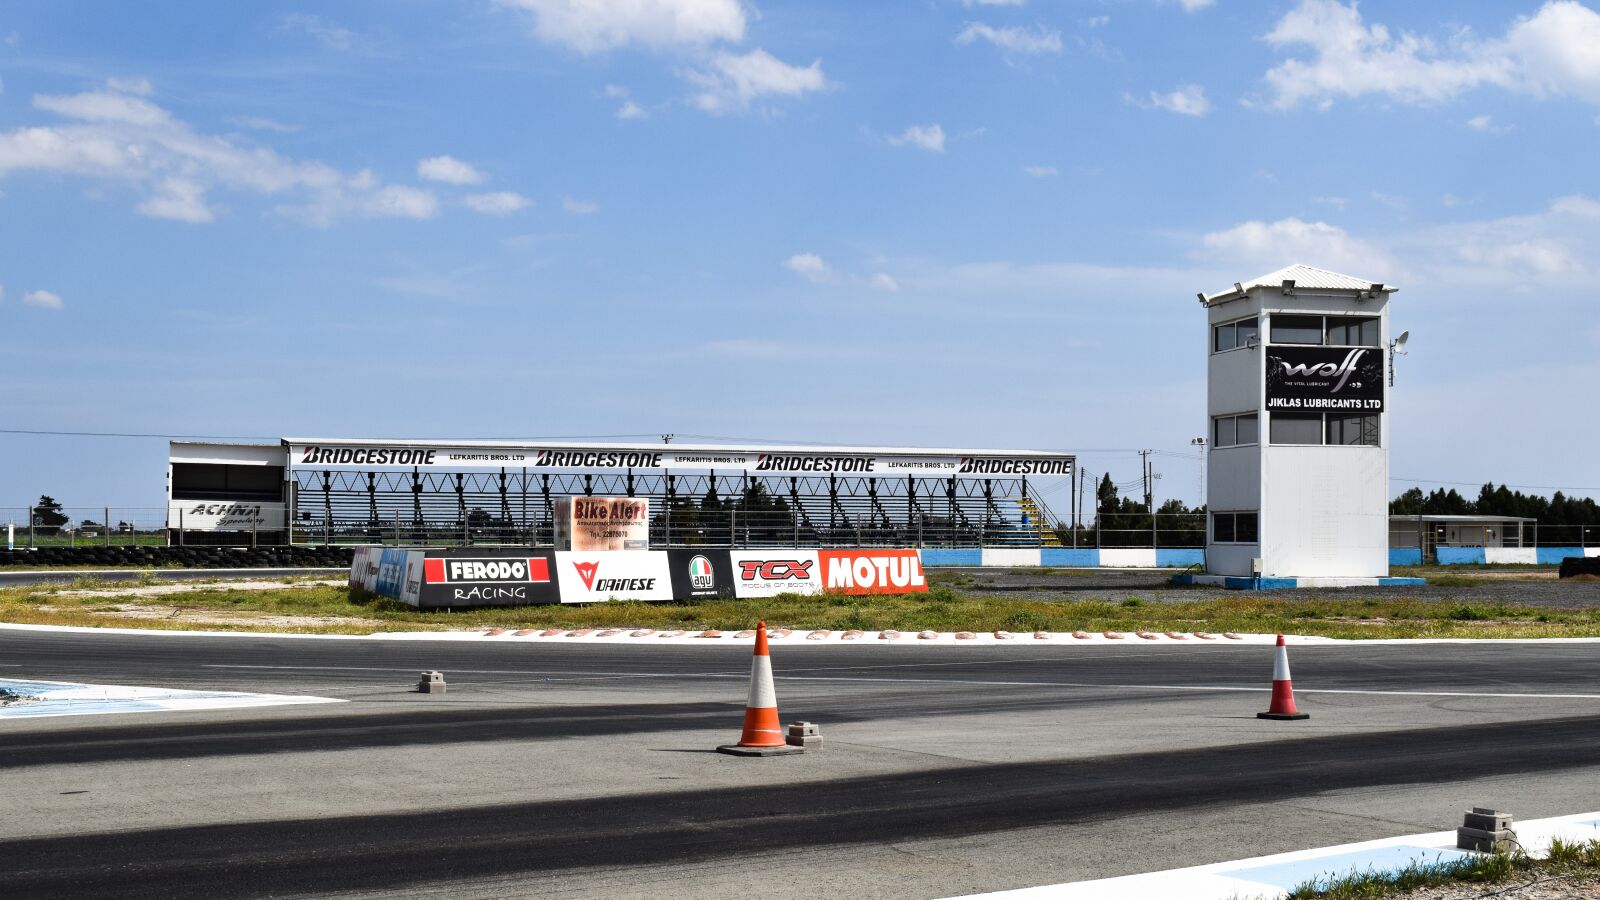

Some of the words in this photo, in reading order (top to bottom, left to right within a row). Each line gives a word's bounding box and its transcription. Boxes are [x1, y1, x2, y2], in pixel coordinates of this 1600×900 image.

[1268, 398, 1301, 408] JIKLAS
[1303, 398, 1362, 409] LUBRICANTS
[1364, 399, 1381, 409] LTD
[301, 445, 436, 465] BRIDGESTONE
[535, 450, 663, 468] BRIDGESTONE
[755, 453, 876, 472] BRIDGESTONE
[958, 457, 1072, 475] BRIDGESTONE
[188, 503, 261, 516] ACHNA
[574, 500, 608, 519] Bike
[609, 501, 646, 519] Alert
[450, 561, 525, 580] FERODO
[738, 559, 813, 580] TCX
[828, 556, 925, 589] MOTUL
[454, 586, 526, 599] RACING
[595, 578, 656, 592] DAINESE
